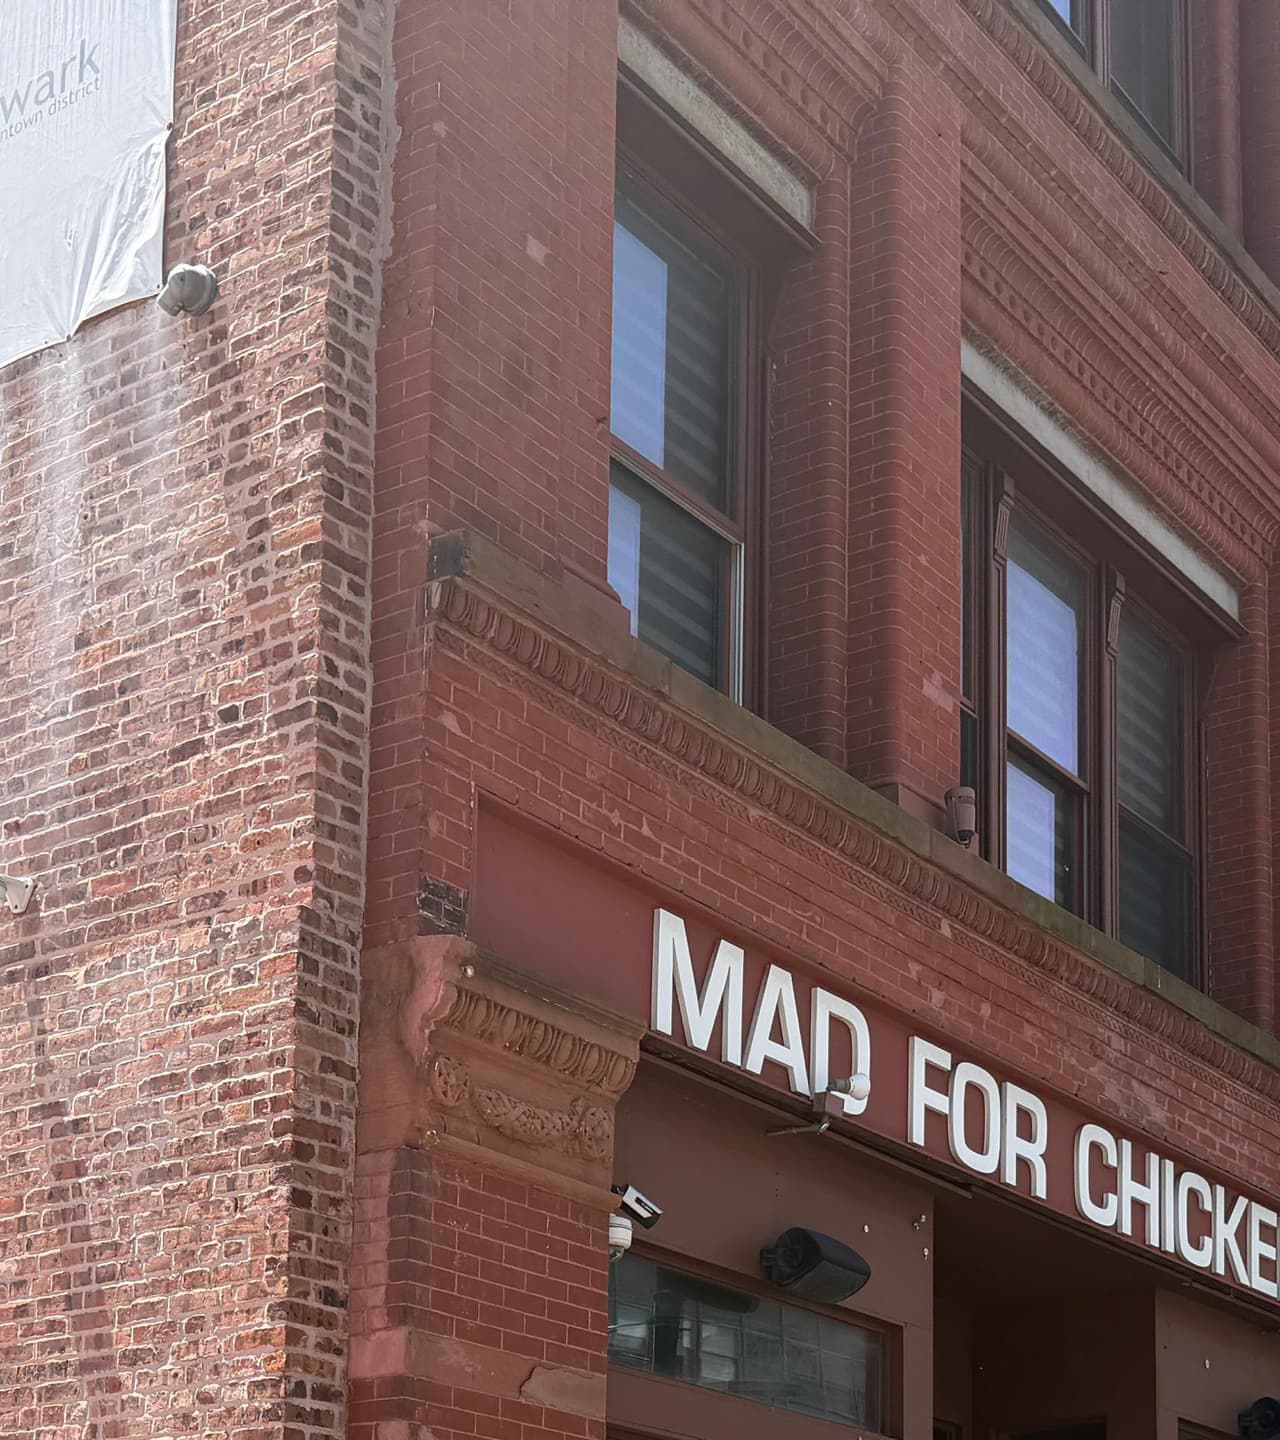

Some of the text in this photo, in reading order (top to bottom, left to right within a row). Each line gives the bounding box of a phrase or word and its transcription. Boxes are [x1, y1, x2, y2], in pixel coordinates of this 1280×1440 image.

[48, 77, 100, 116] district
[650, 907, 872, 1117] MAD
[907, 1034, 1048, 1201] FOR
